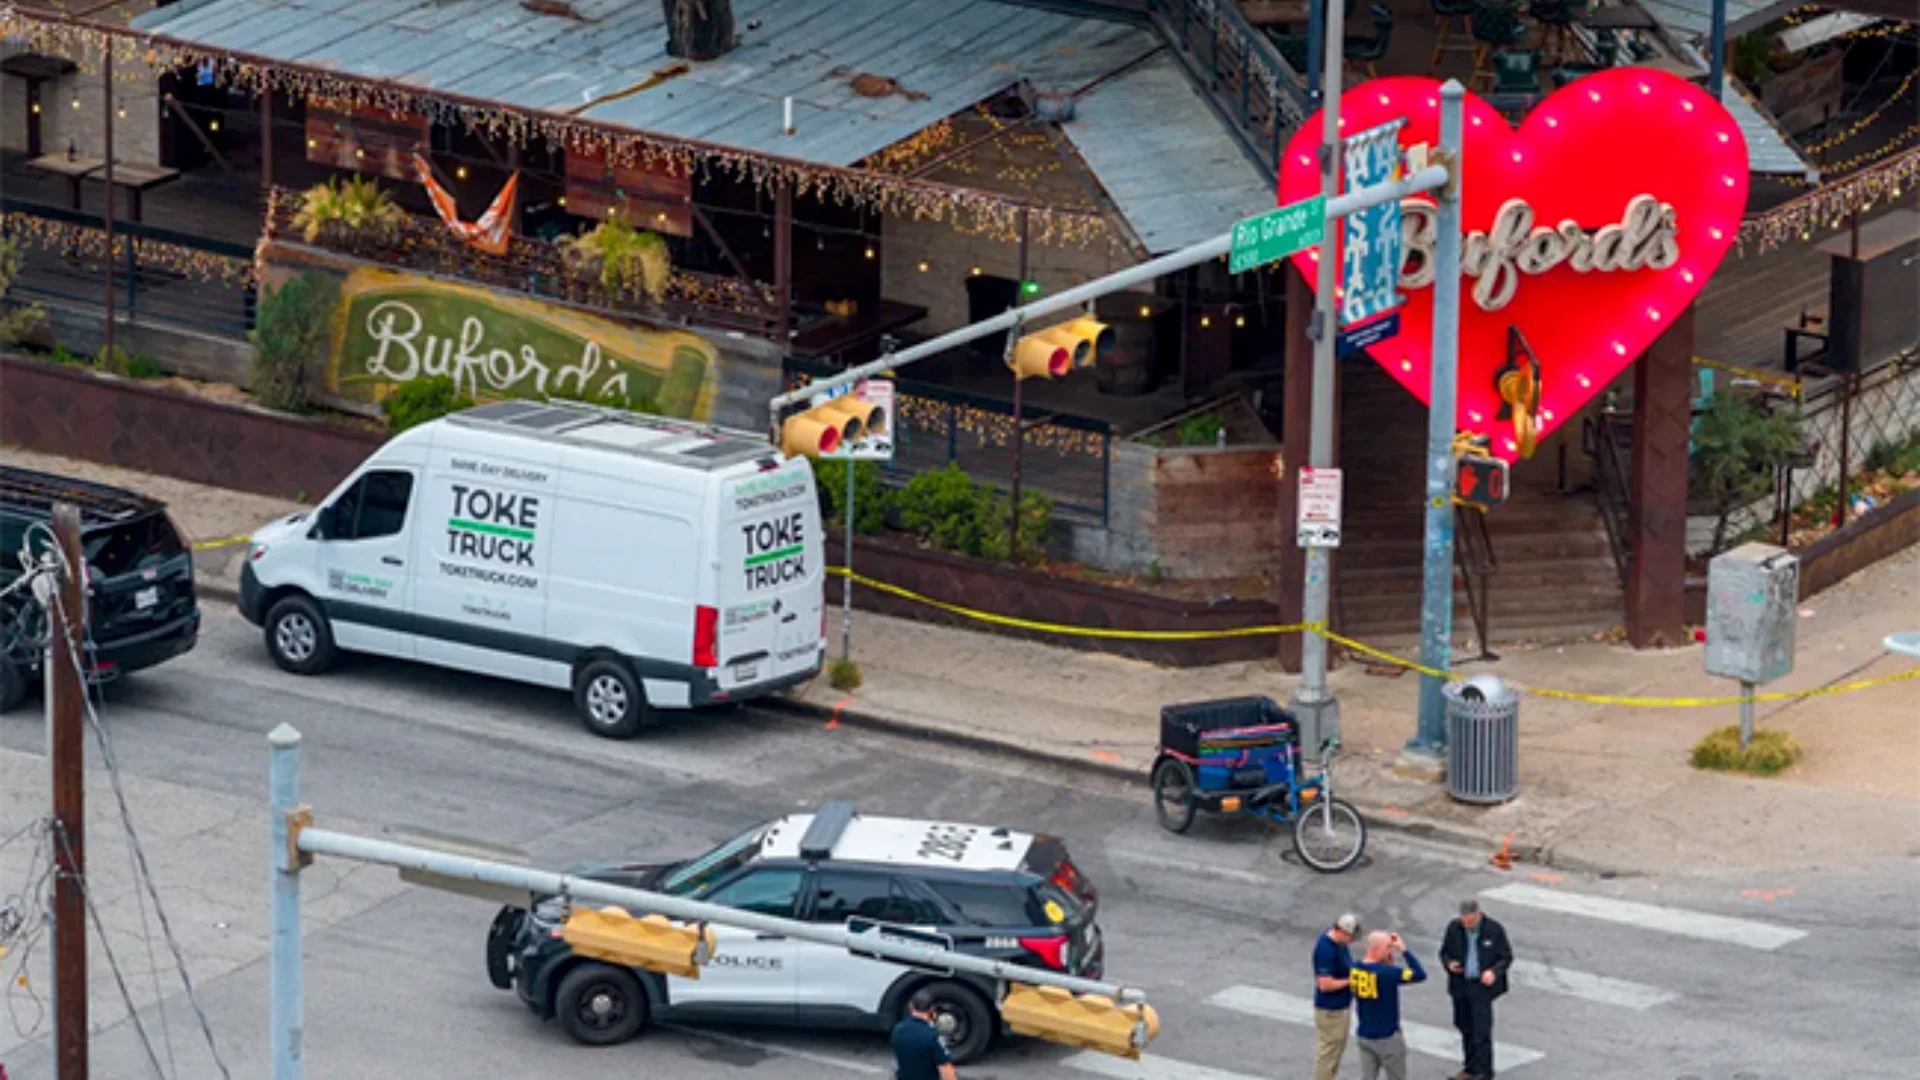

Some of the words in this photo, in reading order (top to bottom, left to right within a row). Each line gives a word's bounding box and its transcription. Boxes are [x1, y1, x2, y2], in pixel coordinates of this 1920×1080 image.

[1237, 224, 1259, 248] Rio
[1260, 206, 1307, 241] Grande
[451, 485, 539, 529] TOKE
[447, 529, 535, 567] TRUCK
[742, 513, 803, 554] TOKE
[439, 562, 538, 588] TOKETRUCK.COM
[744, 554, 805, 591] TRUCK
[706, 954, 783, 970] OLICE
[1350, 967, 1378, 999] FBI
